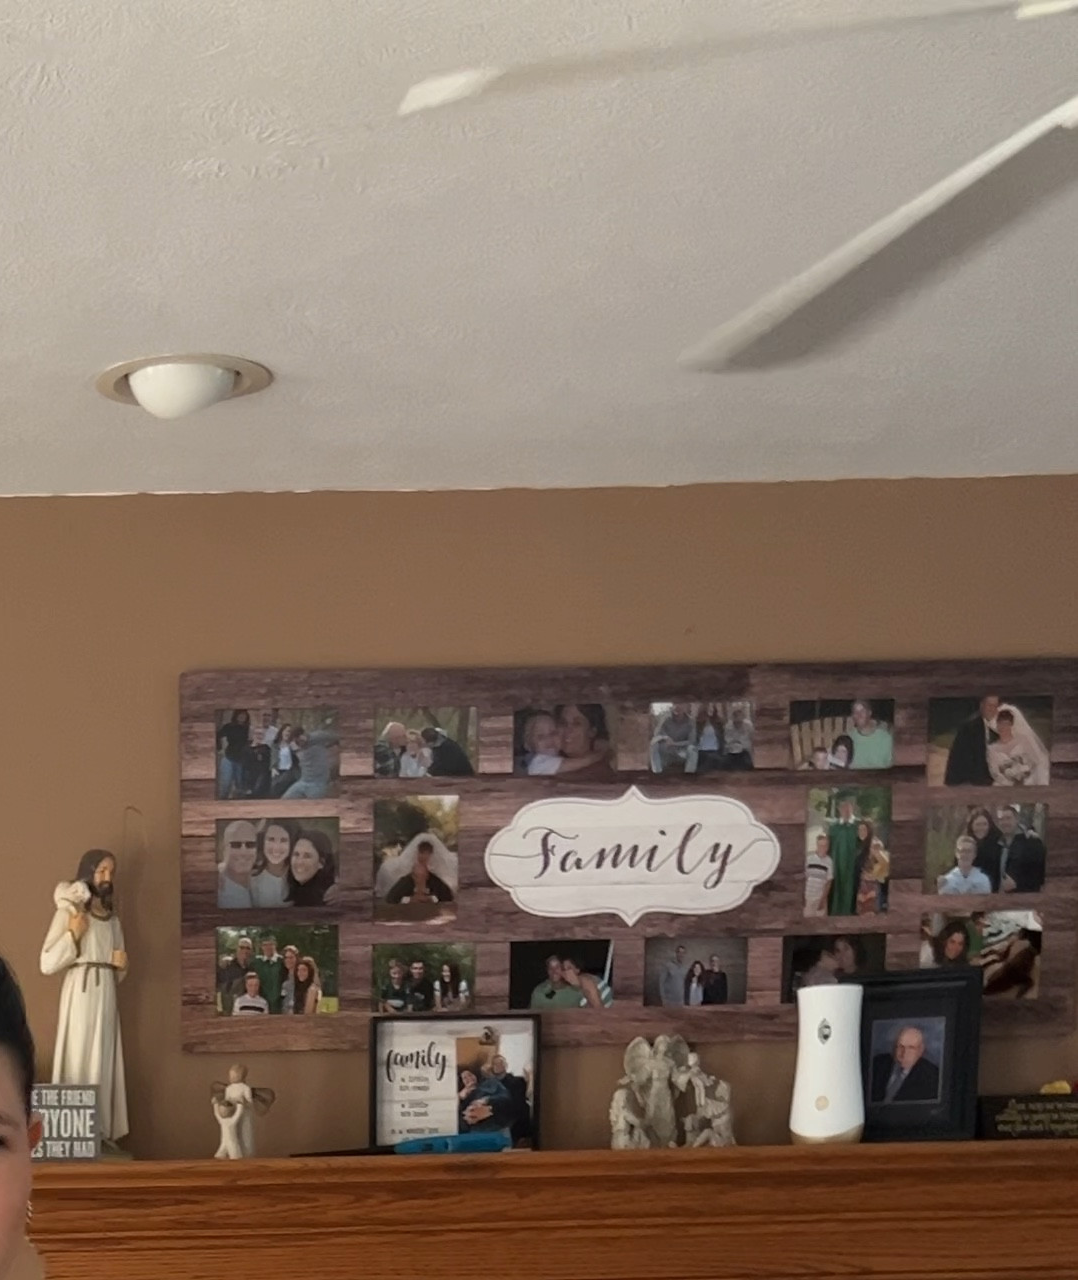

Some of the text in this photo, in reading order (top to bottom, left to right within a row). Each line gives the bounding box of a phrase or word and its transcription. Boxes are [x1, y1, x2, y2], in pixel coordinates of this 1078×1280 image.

[489, 822, 773, 889] Family
[386, 1041, 447, 1083] family
[41, 1089, 59, 1106] THE
[61, 1089, 96, 1106] FRIEND
[37, 1108, 96, 1138] RYONE
[45, 1141, 71, 1158] THEY
[73, 1141, 96, 1158] HAD
